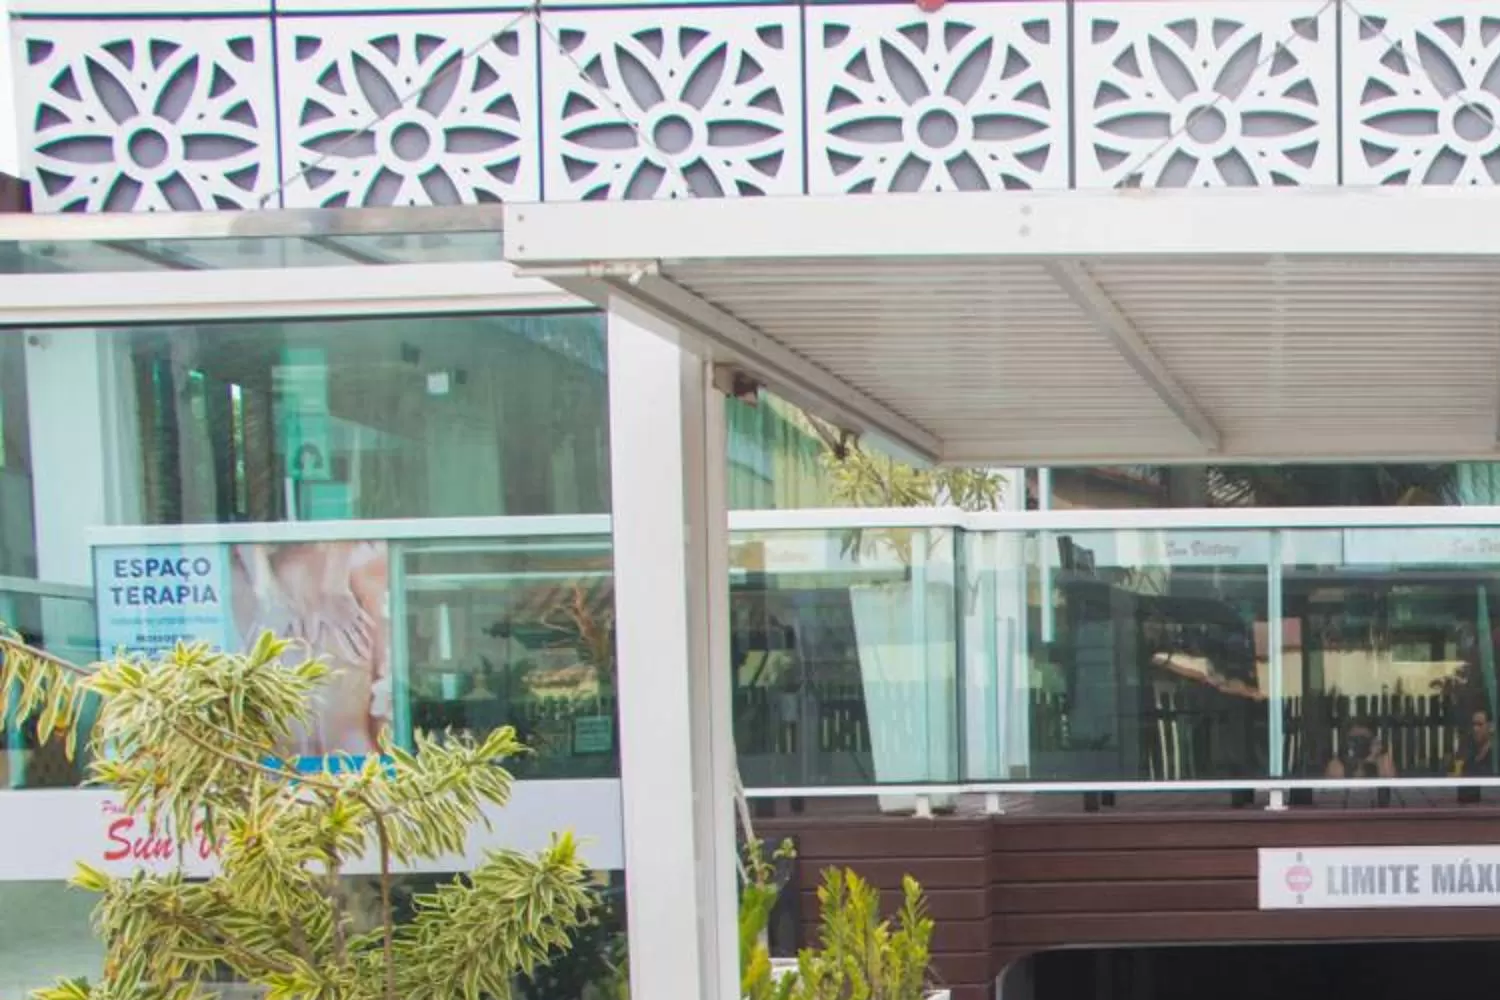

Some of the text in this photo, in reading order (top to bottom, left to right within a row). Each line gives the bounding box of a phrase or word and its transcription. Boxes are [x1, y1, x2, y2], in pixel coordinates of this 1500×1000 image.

[114, 556, 212, 582] ESPAÇO
[110, 584, 218, 605] TERAPIA
[103, 816, 174, 860] Sun
[1326, 863, 1420, 896] LIMITE
